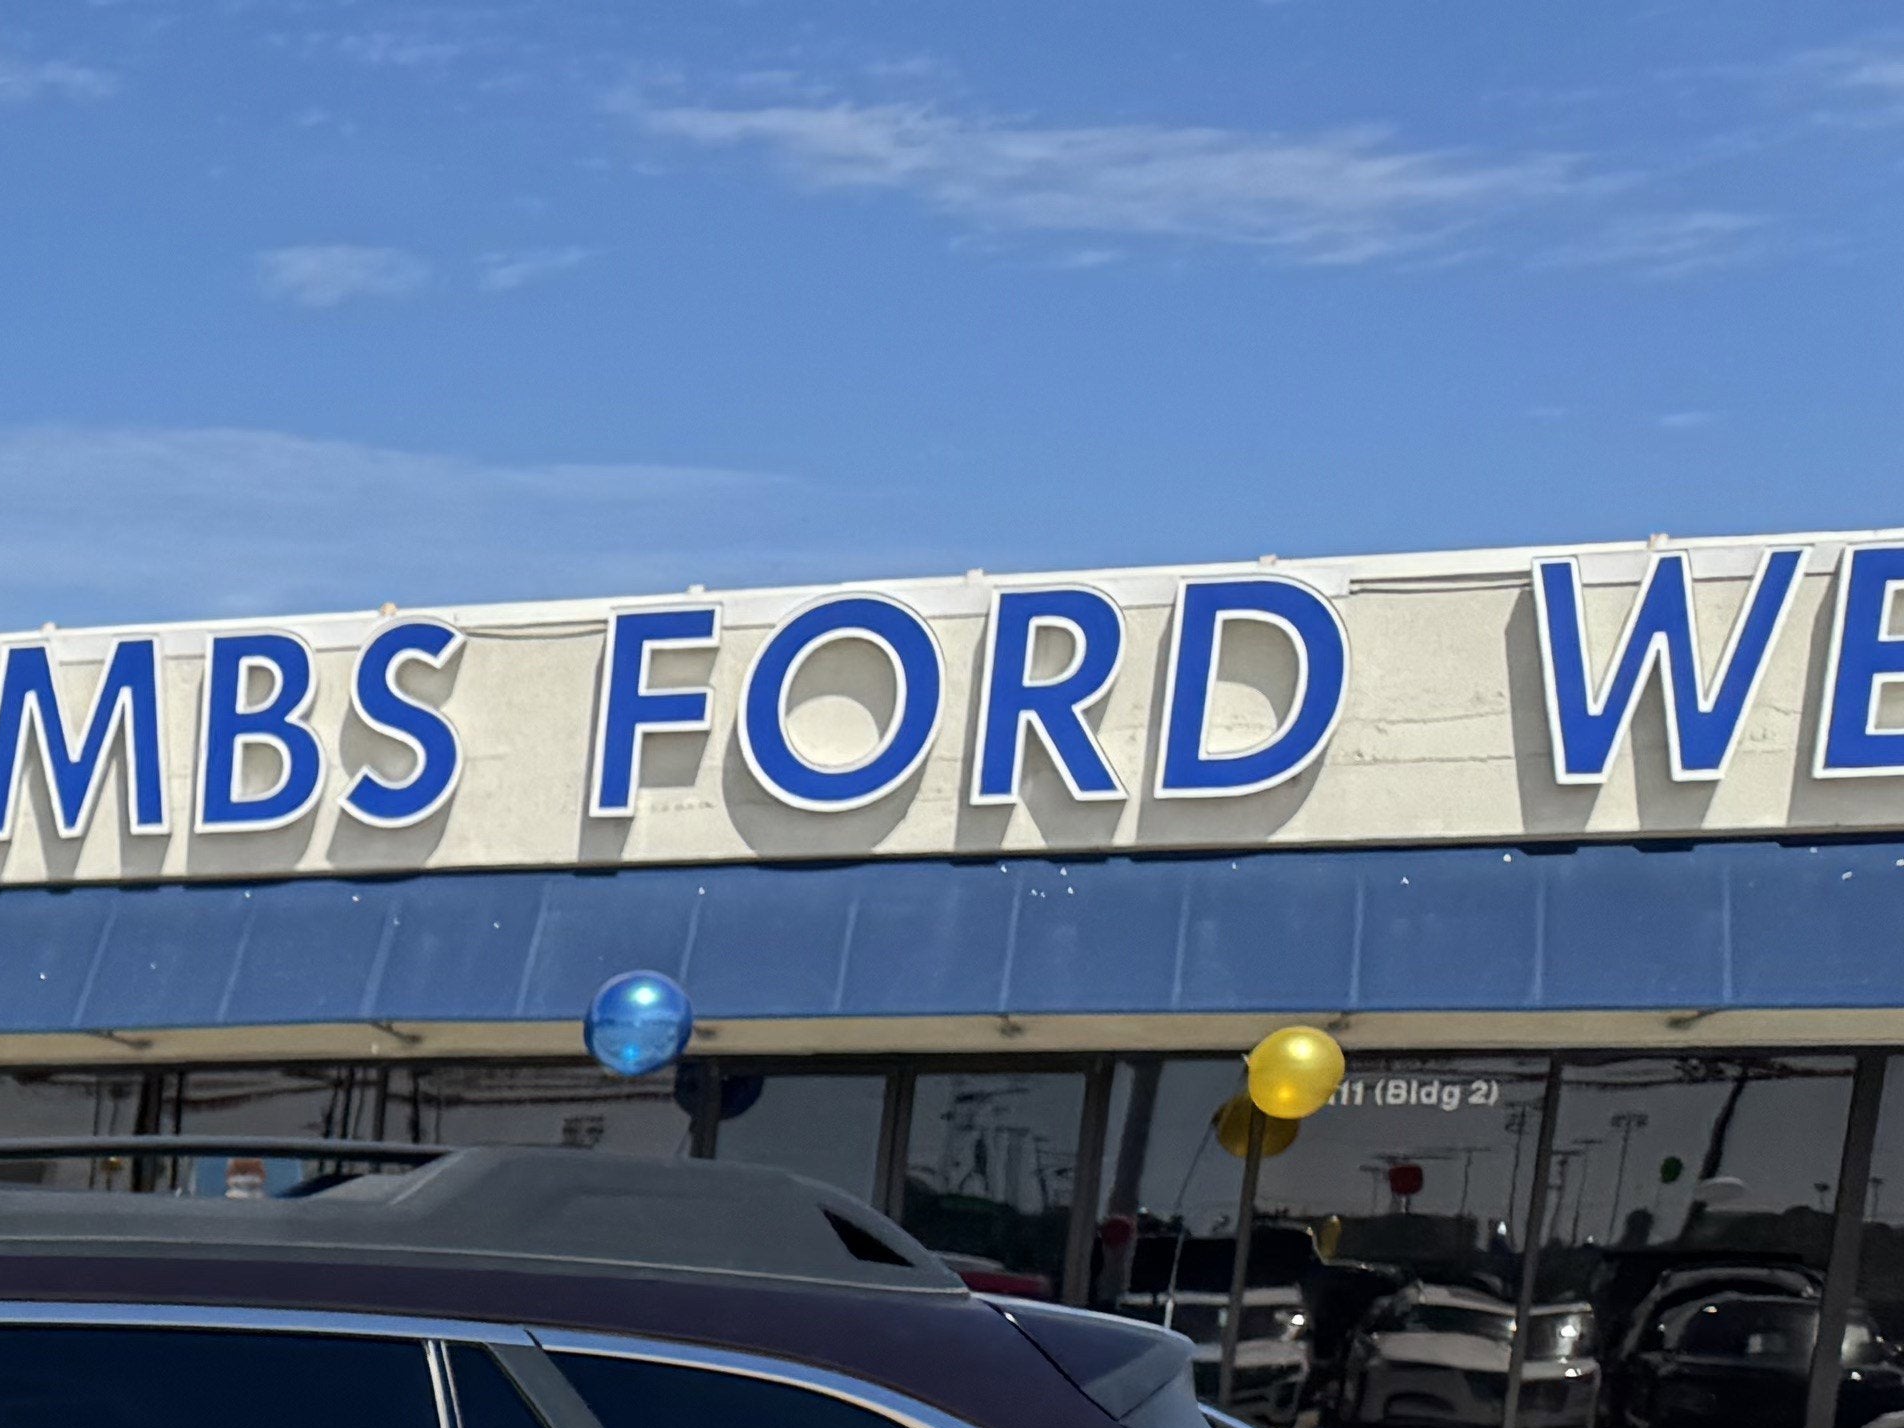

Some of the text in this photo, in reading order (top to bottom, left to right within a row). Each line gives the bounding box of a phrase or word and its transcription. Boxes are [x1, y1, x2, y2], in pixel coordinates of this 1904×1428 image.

[590, 574, 1354, 818] FORD
[1374, 1078, 1461, 1112] (Bldg
[1466, 1078, 1500, 1106] 2)
